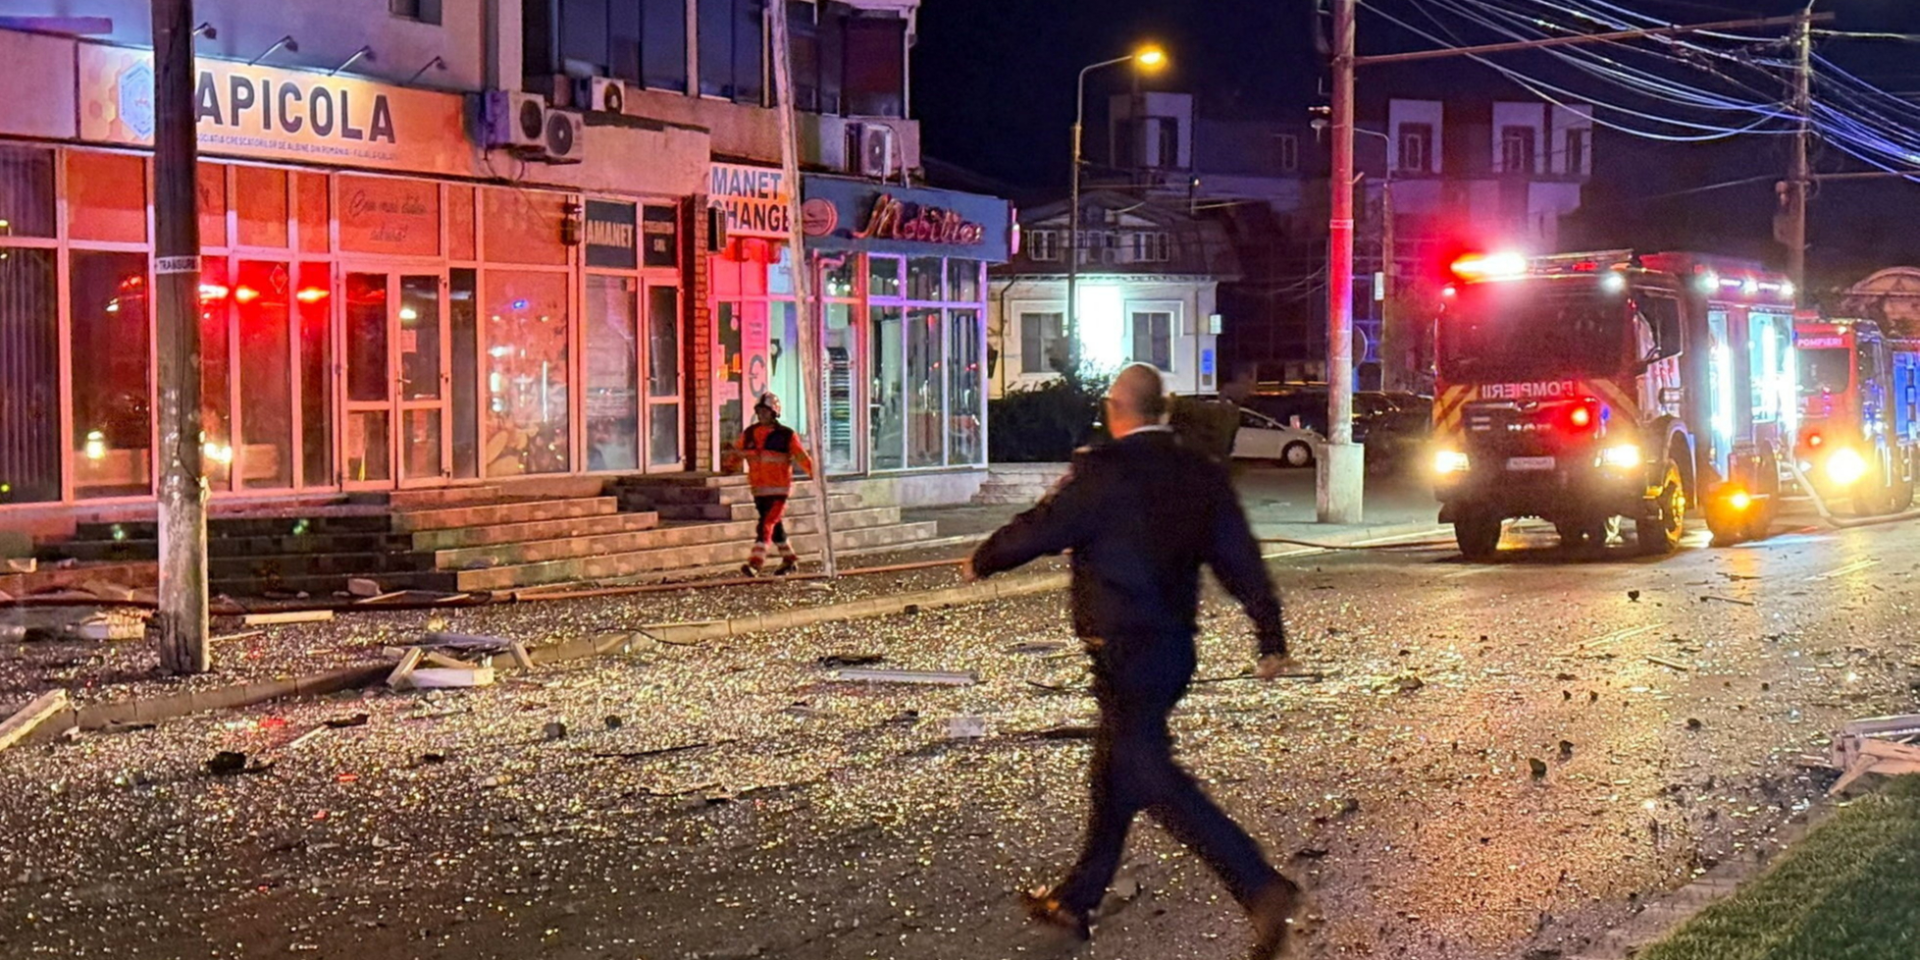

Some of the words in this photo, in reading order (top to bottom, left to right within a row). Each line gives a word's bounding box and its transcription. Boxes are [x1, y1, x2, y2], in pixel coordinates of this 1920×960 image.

[195, 71, 396, 144] APICOLA
[586, 219, 633, 248] AMANET
[1797, 337, 1842, 348] POMPIERI
